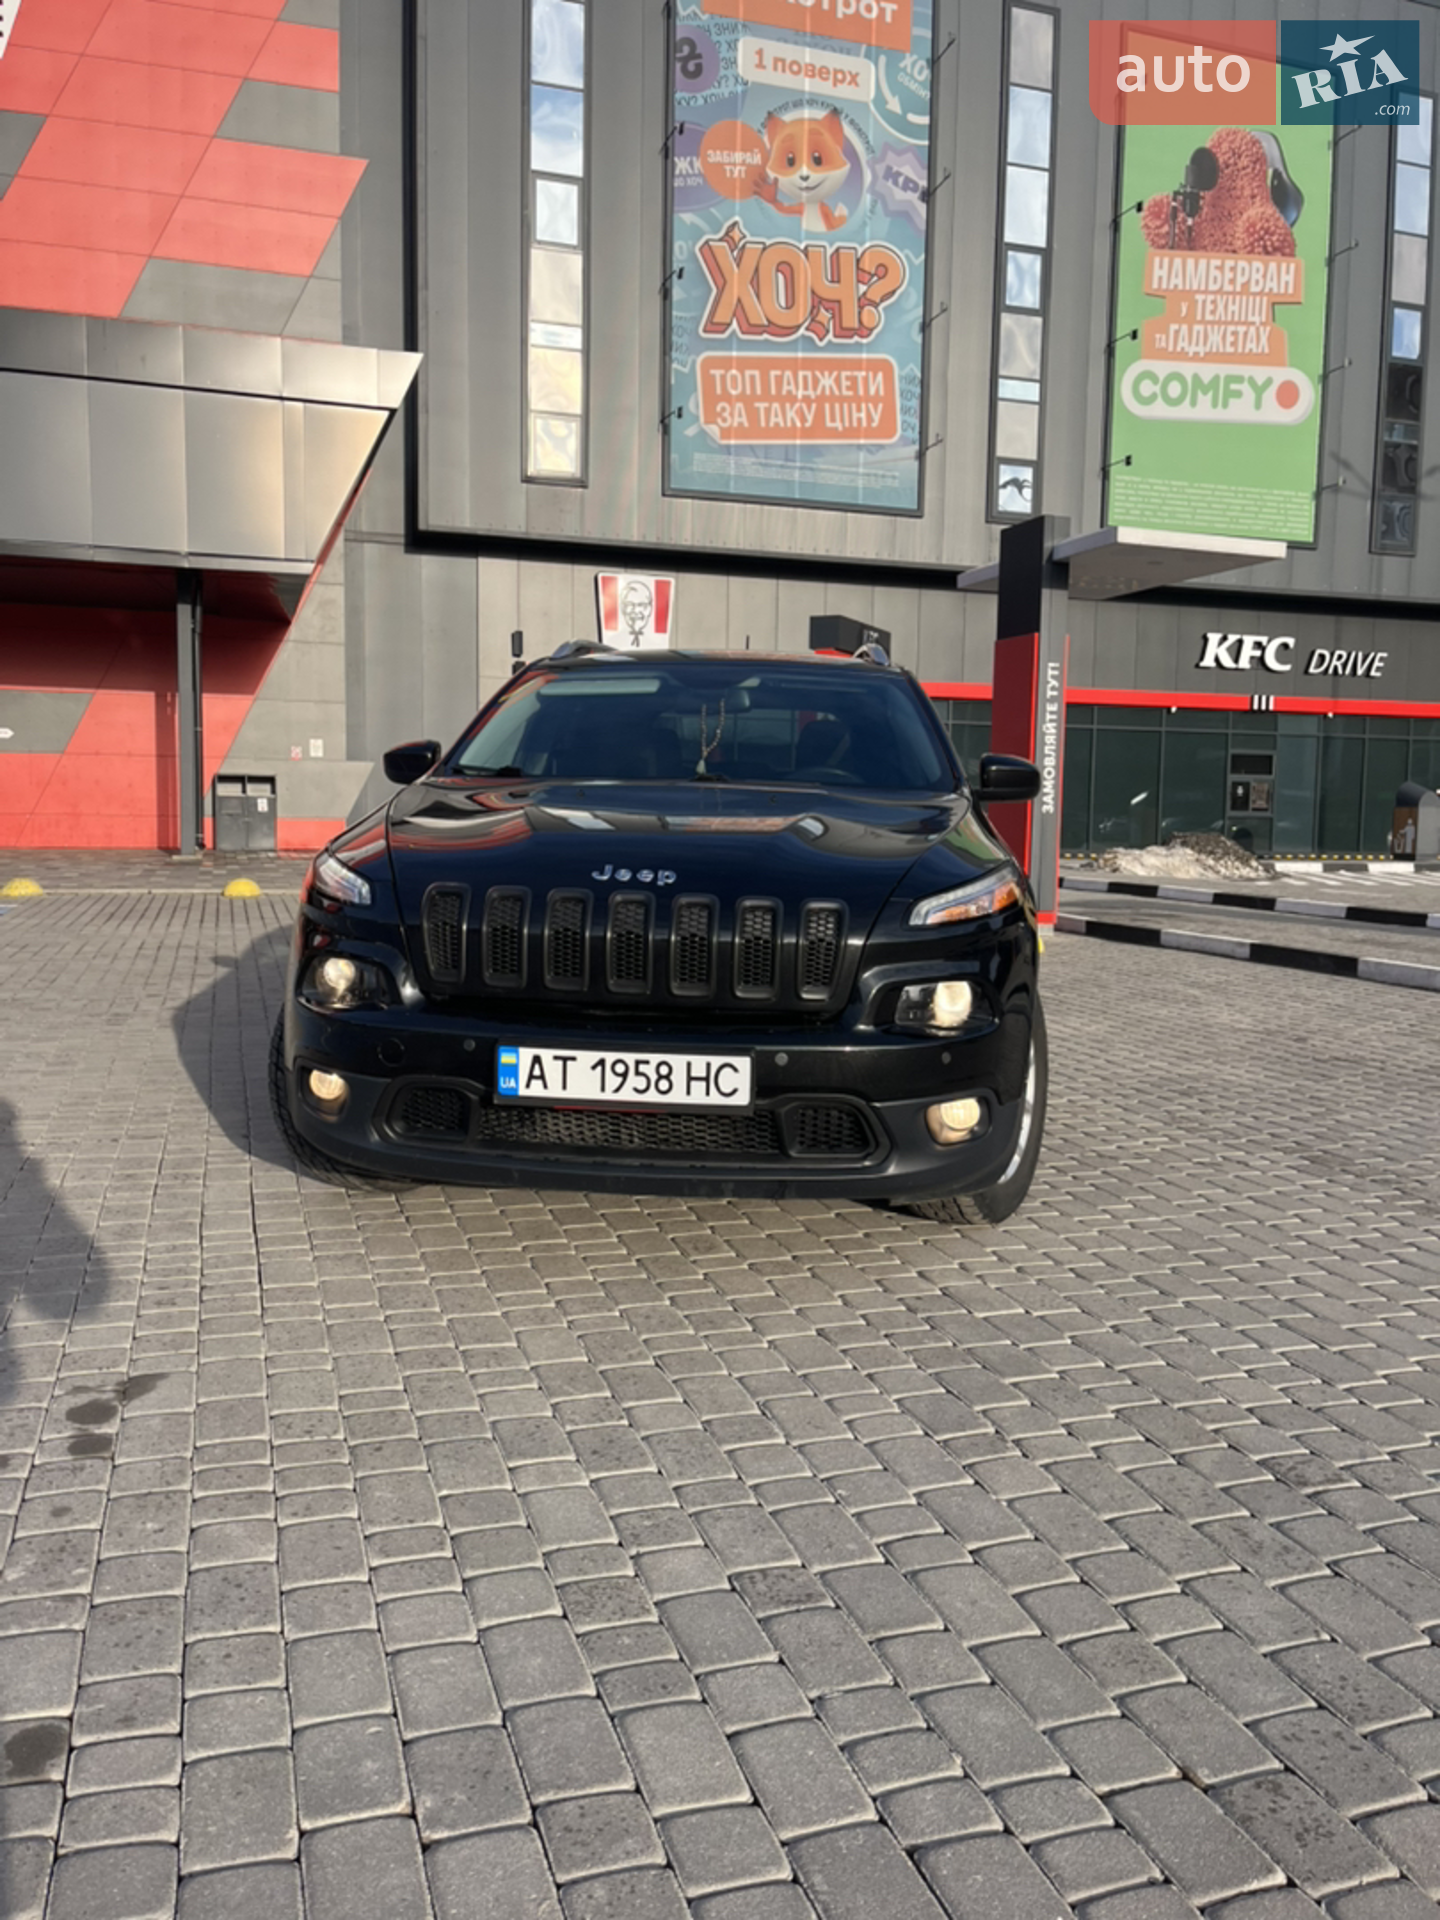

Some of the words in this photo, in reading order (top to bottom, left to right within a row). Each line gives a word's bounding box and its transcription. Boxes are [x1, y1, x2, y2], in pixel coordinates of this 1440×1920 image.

[754, 47, 767, 70] 1
[772, 55, 861, 89] поверх
[707, 149, 762, 166] ЗАБИРАЙ
[723, 165, 747, 179] ТУТ
[697, 239, 908, 344] ХОЧ?
[1151, 256, 1296, 294] НАМБЕРВАН
[1195, 294, 1269, 327] ТЕХНІЦІ
[1167, 323, 1271, 358] ГАДЖЕТАХ
[709, 369, 762, 396] ТОП
[769, 369, 885, 399] ГАДЖЕТИ
[1131, 369, 1274, 411] COMFY
[716, 402, 749, 428] ЗА
[754, 402, 817, 428] ТАКУ
[824, 402, 883, 432] ЦІНУ
[1197, 632, 1296, 672] KFC
[1306, 647, 1389, 678] DRIVE
[1046, 662, 1060, 700] ТУТ!
[1041, 701, 1059, 814] ЗАМОВЛЯЙТЕ
[591, 864, 677, 886] Jeep
[501, 1076, 517, 1089] UA
[525, 1054, 577, 1091] AT
[590, 1057, 674, 1095] 1958
[685, 1060, 740, 1098] HC
